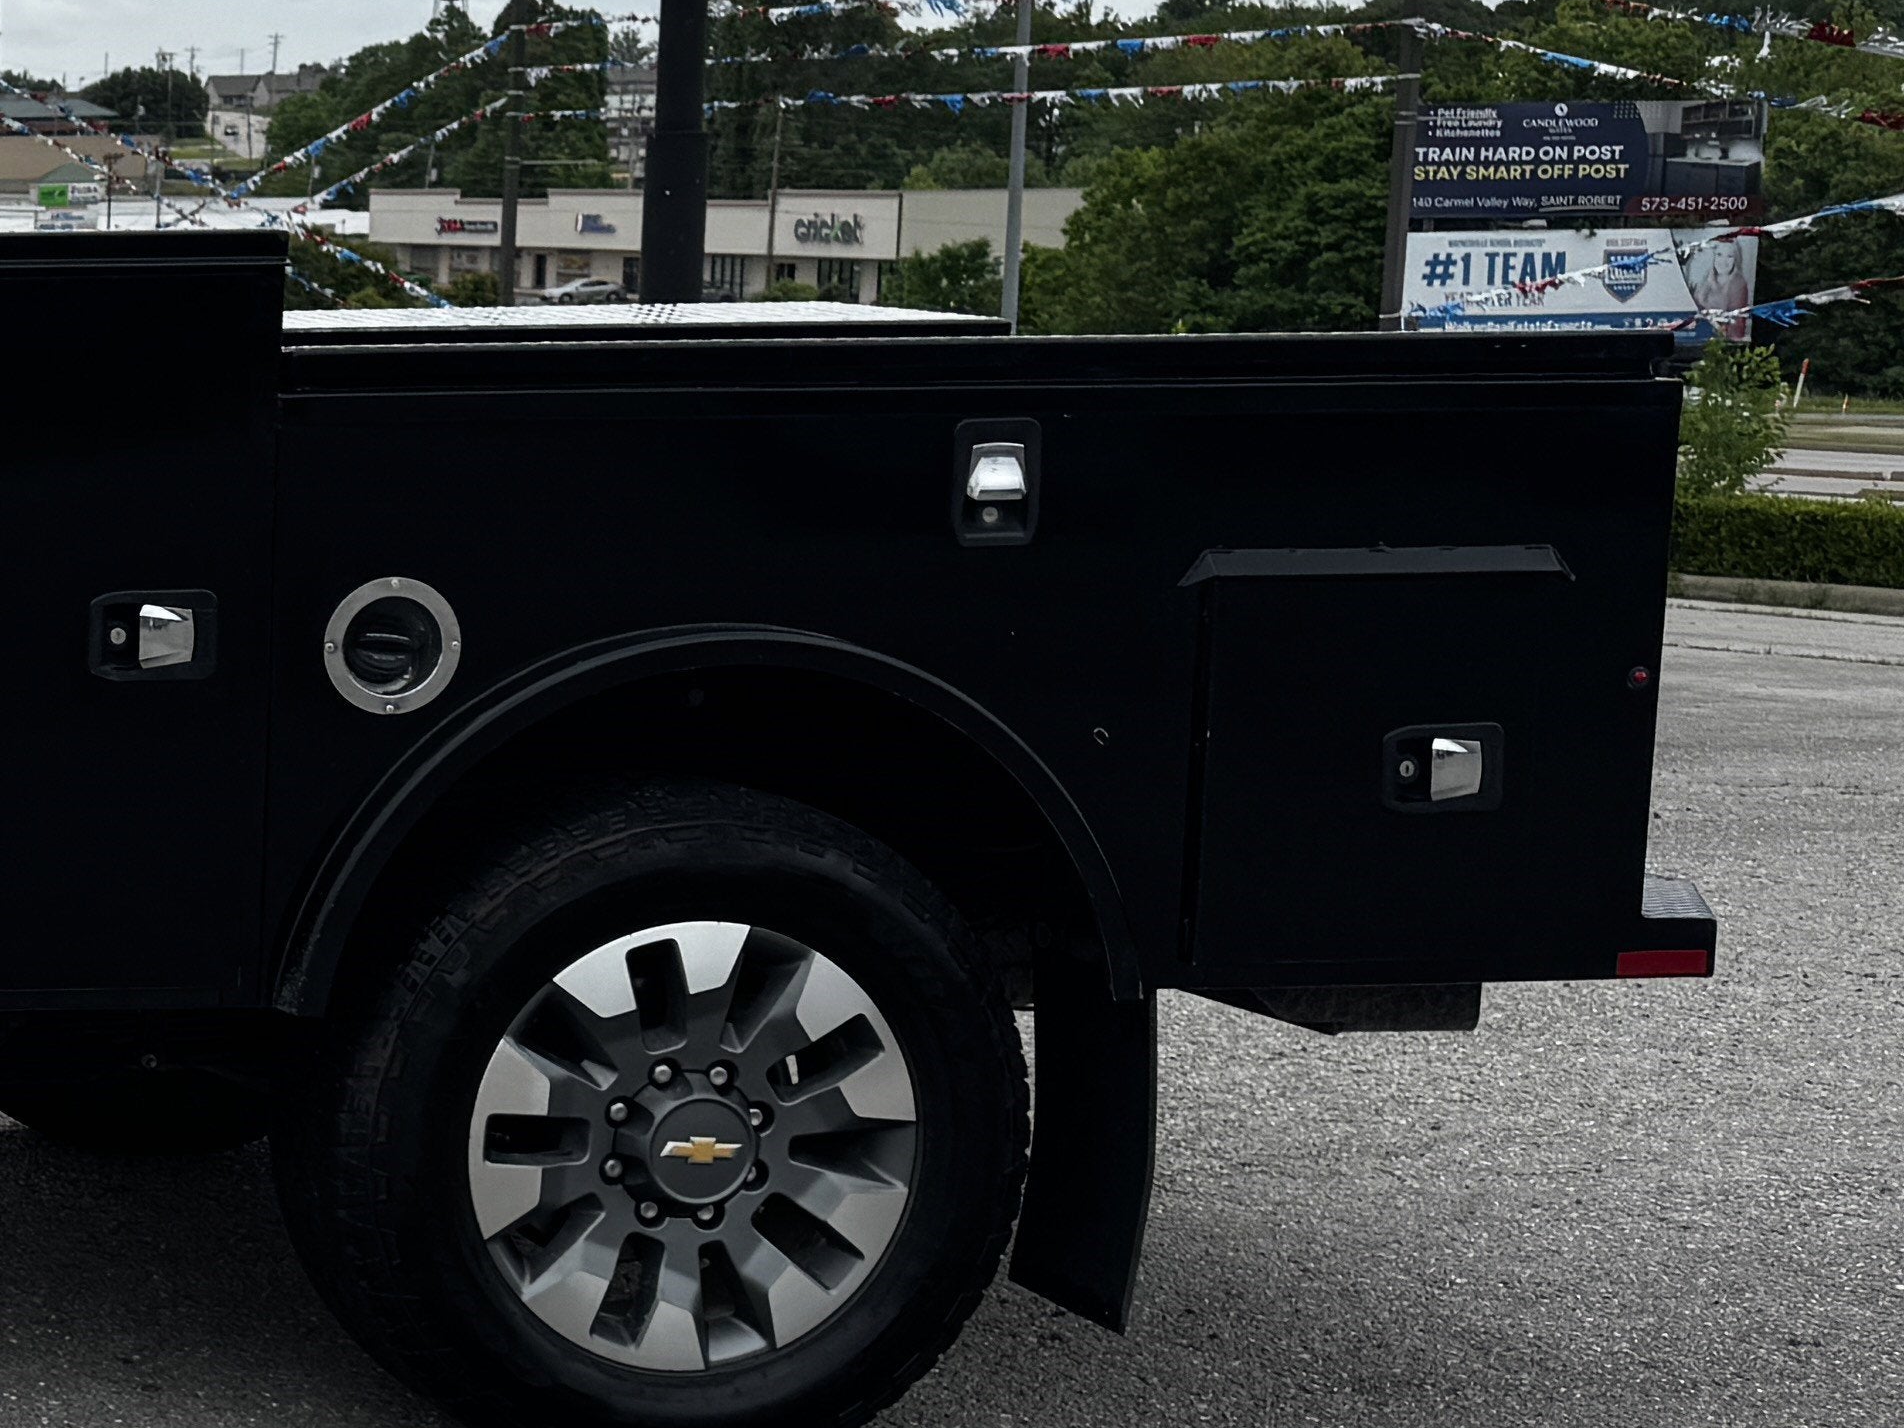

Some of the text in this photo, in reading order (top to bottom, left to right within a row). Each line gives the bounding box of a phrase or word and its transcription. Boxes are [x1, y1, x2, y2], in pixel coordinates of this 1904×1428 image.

[1522, 117, 1599, 128] CANDLEWOOD
[1414, 145, 1624, 163] TRAIN HARD ON POST
[1413, 163, 1630, 181] STAY SMART OFF POST
[1412, 195, 1623, 209] 140 Carmel Valley Way, SAINT ROBERT
[1640, 196, 1749, 213] 573-451-2500
[793, 212, 866, 245] cricket
[1421, 250, 1567, 287] #1 TEAM
